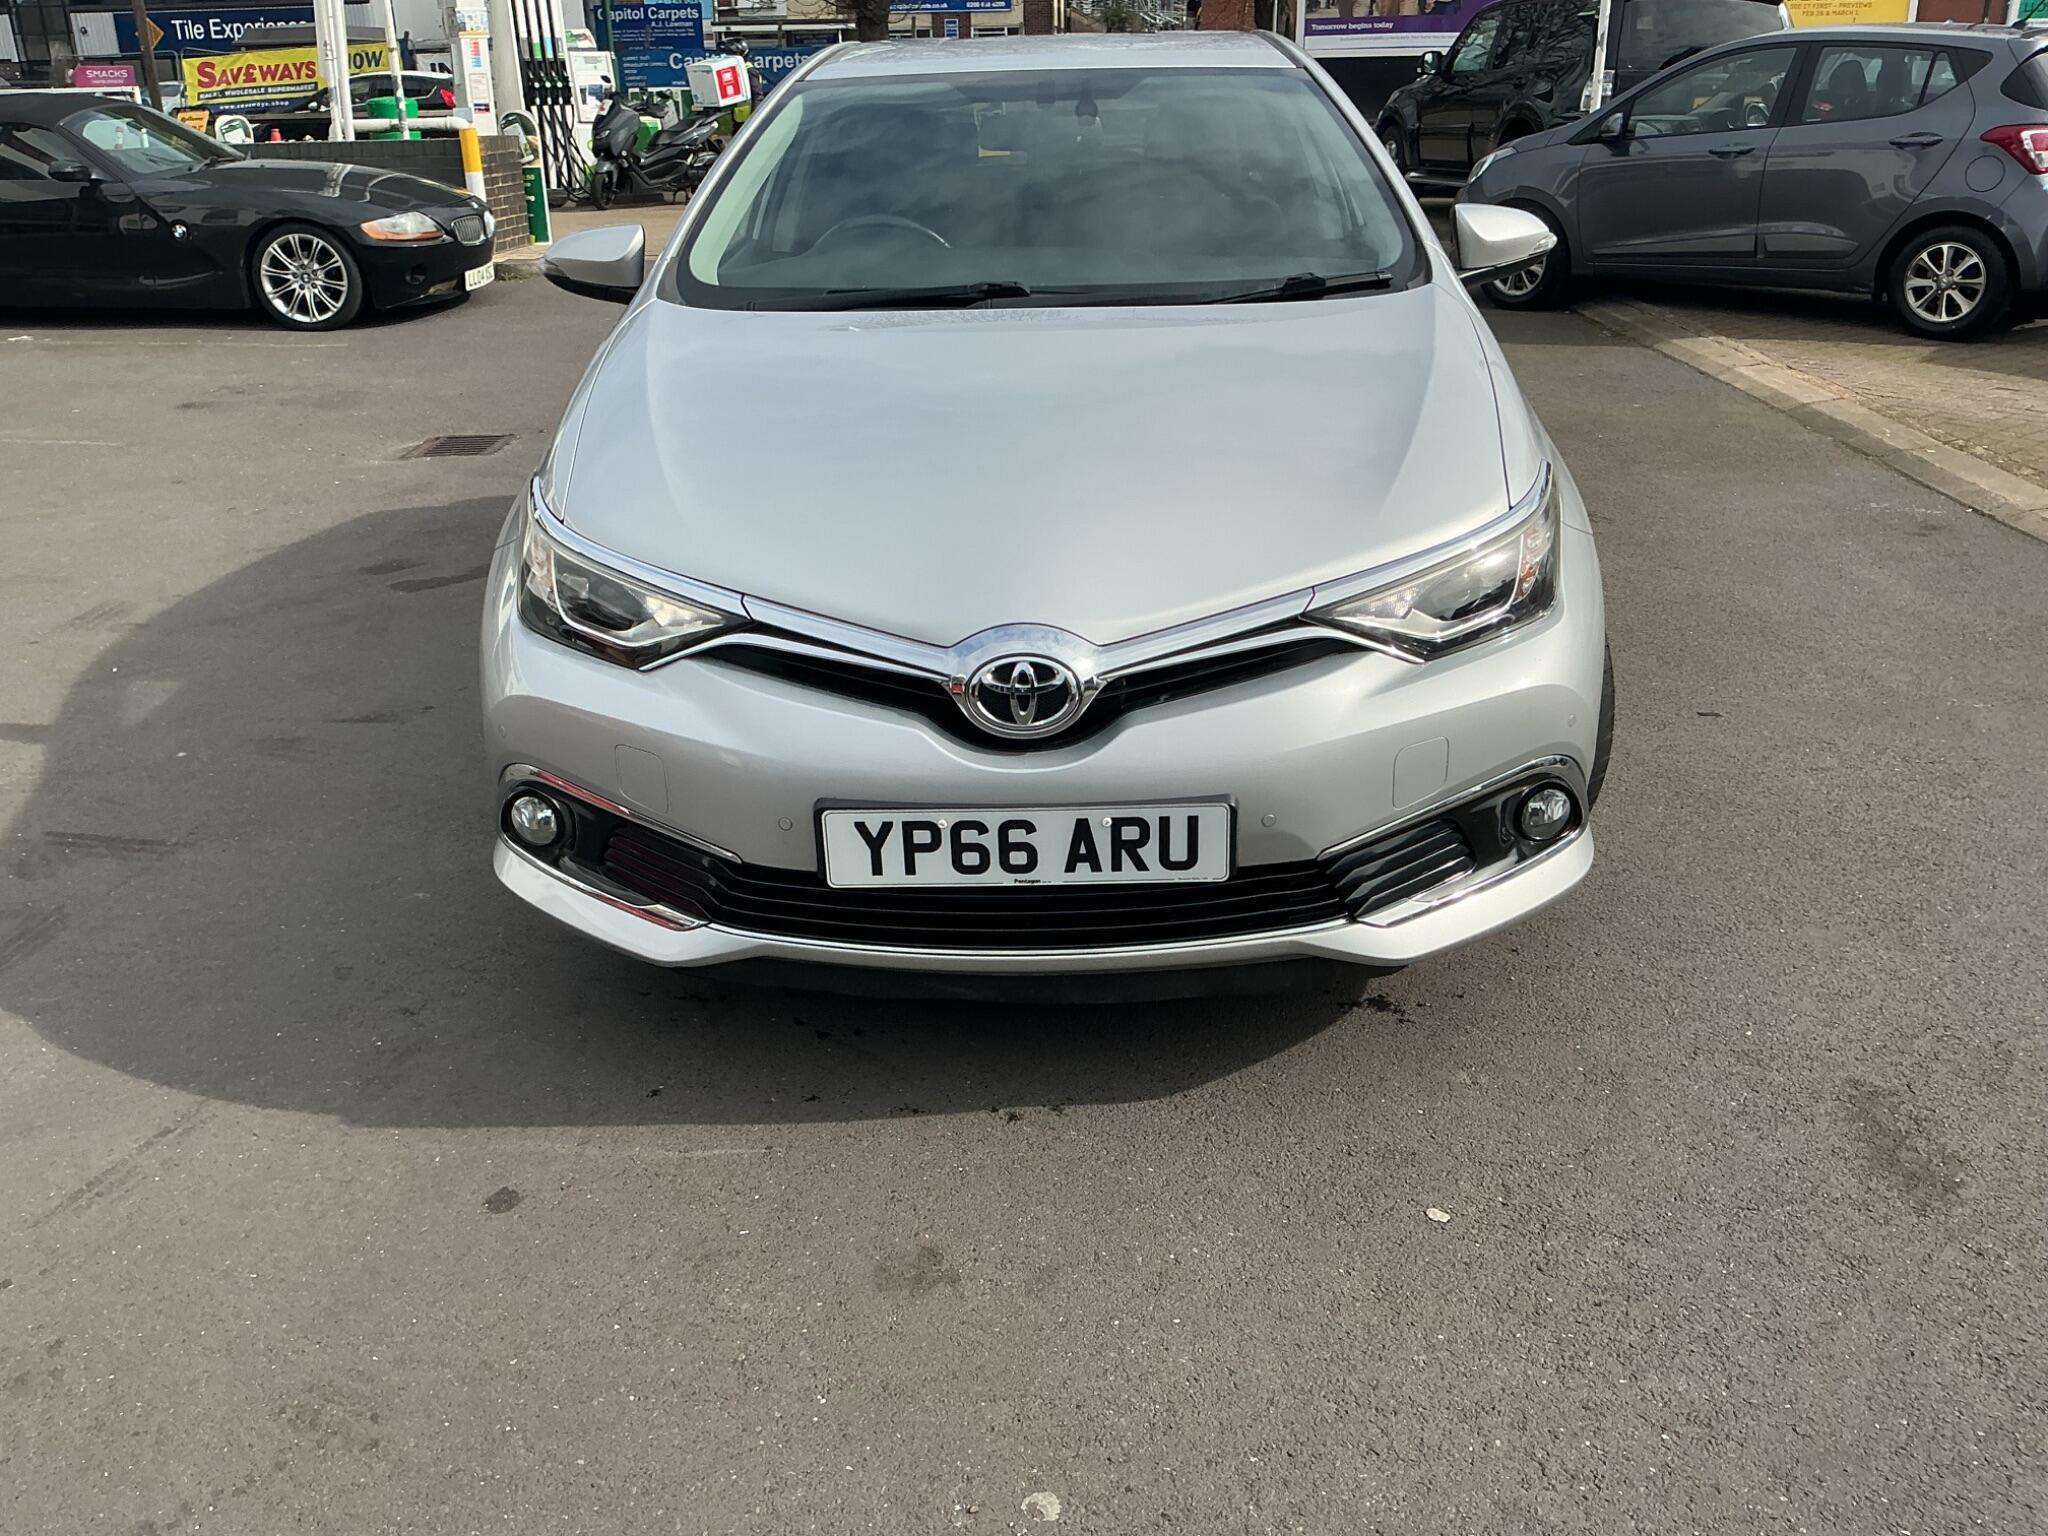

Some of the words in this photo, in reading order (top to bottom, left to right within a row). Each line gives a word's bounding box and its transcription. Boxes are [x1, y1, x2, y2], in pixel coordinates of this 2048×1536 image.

[597, 7, 645, 23] Capitol
[647, 7, 700, 21] Carpets
[171, 19, 205, 40] Tile
[1311, 23, 1347, 31] Tomorrow
[1373, 22, 1394, 30] today
[86, 70, 128, 78] SMACKS
[225, 87, 266, 97] WHOLESALE
[267, 83, 315, 94] SUPERMARKET
[853, 819, 1039, 877] YP66
[1064, 814, 1200, 873] ARU
